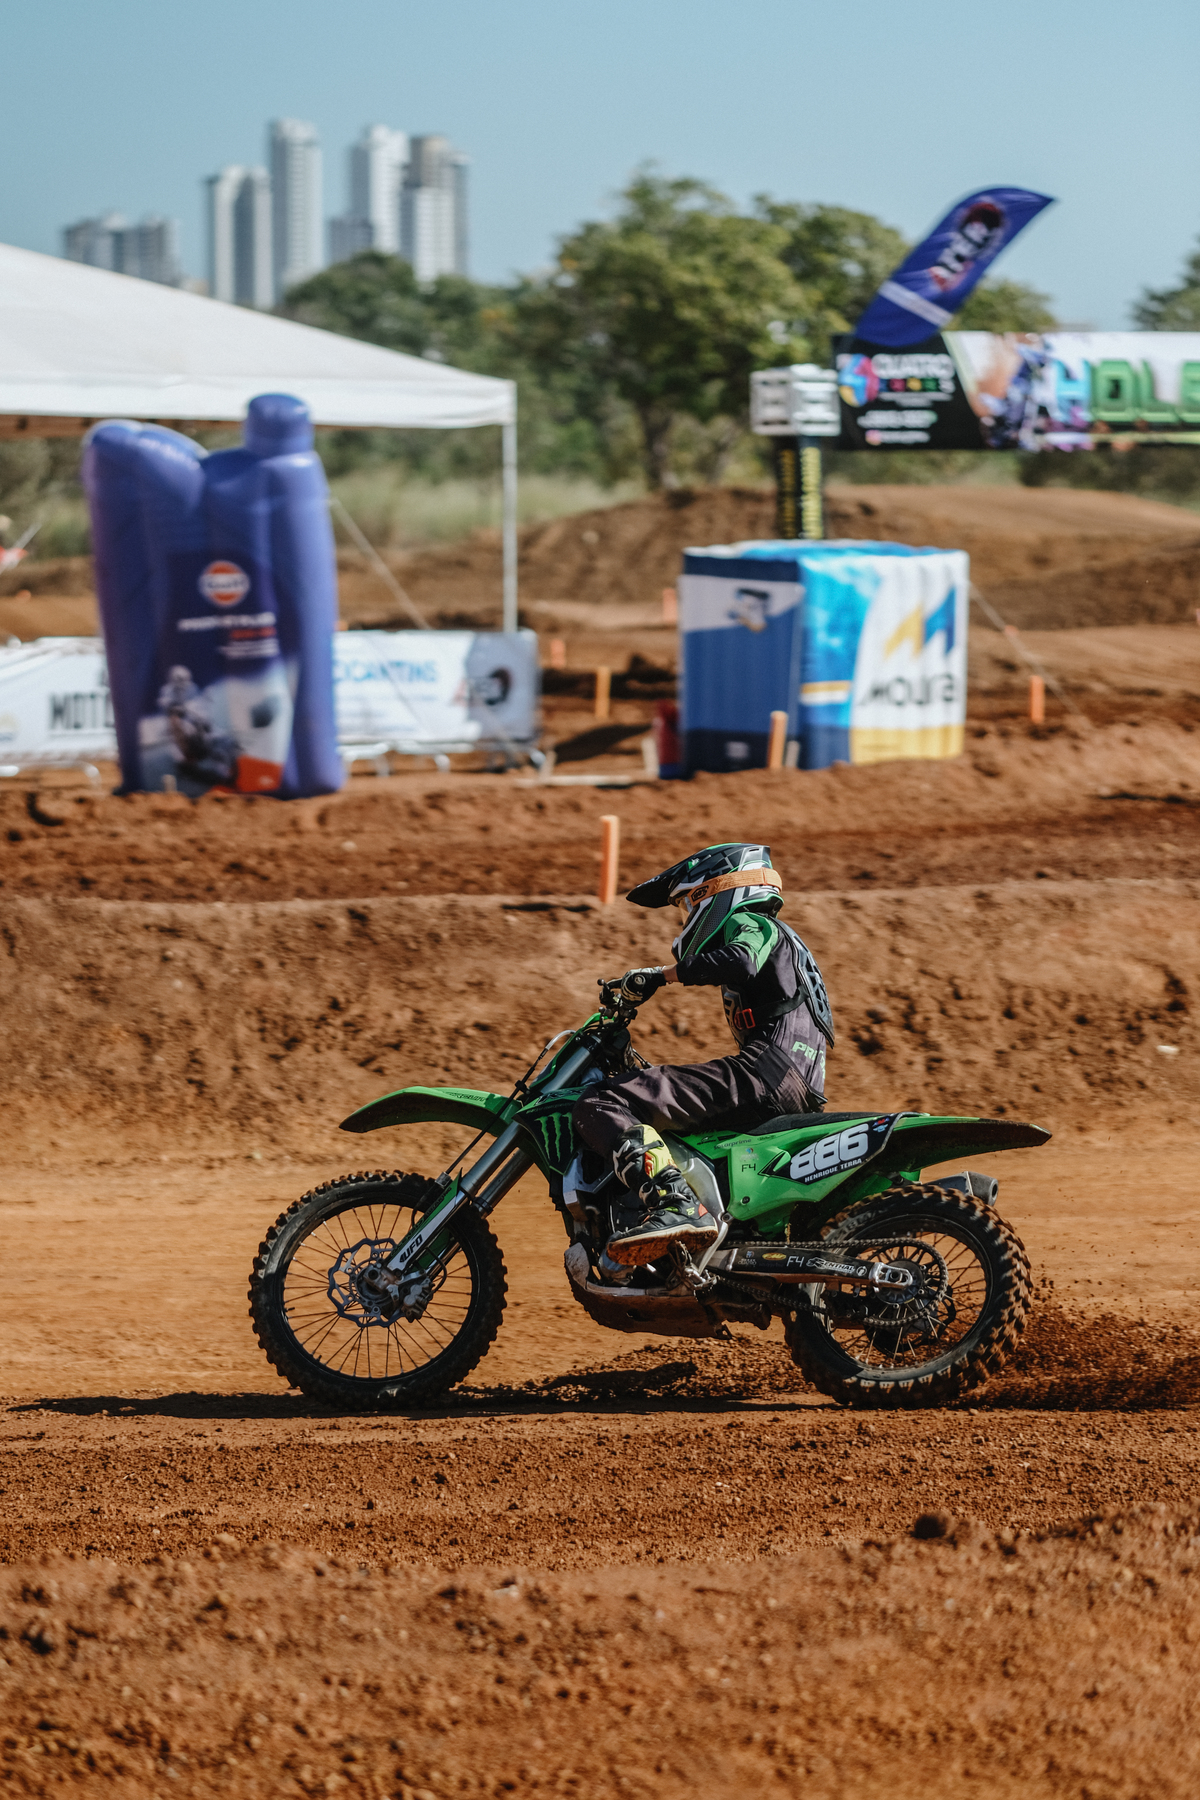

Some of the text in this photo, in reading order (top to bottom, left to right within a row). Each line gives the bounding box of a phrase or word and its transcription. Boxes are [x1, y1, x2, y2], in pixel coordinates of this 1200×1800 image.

[790, 1123, 869, 1180] 886
[741, 1163, 756, 1173] F4
[804, 1158, 863, 1183] HENRIQUE TERRA
[787, 1255, 805, 1267] F4
